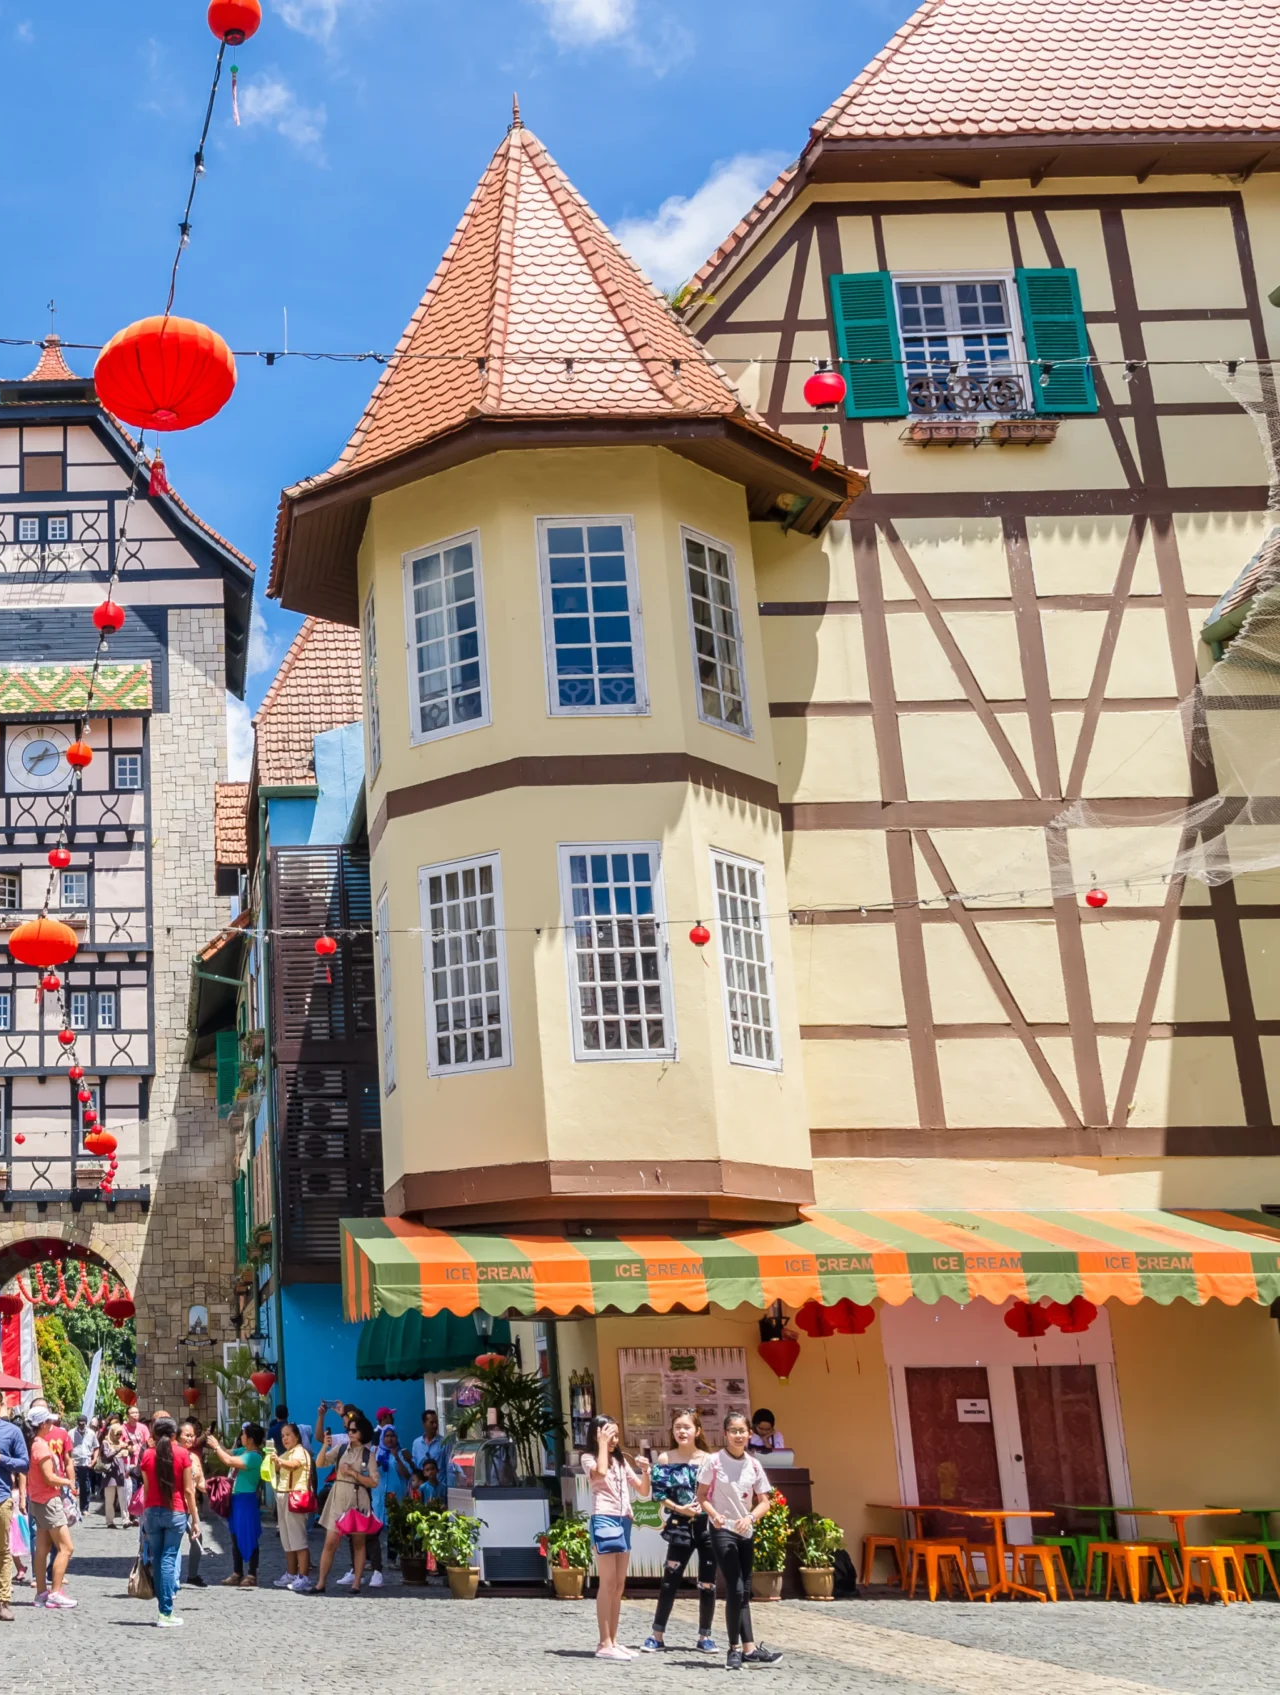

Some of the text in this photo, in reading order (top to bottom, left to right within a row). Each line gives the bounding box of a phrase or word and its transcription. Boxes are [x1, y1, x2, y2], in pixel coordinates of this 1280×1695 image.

[615, 1263, 704, 1278] ICE CREAM
[784, 1257, 874, 1273] ICE CREAM
[932, 1256, 1021, 1271] ICE CREAM
[1104, 1256, 1194, 1270] ICE CREAM
[445, 1266, 535, 1281] ICE CREAM
